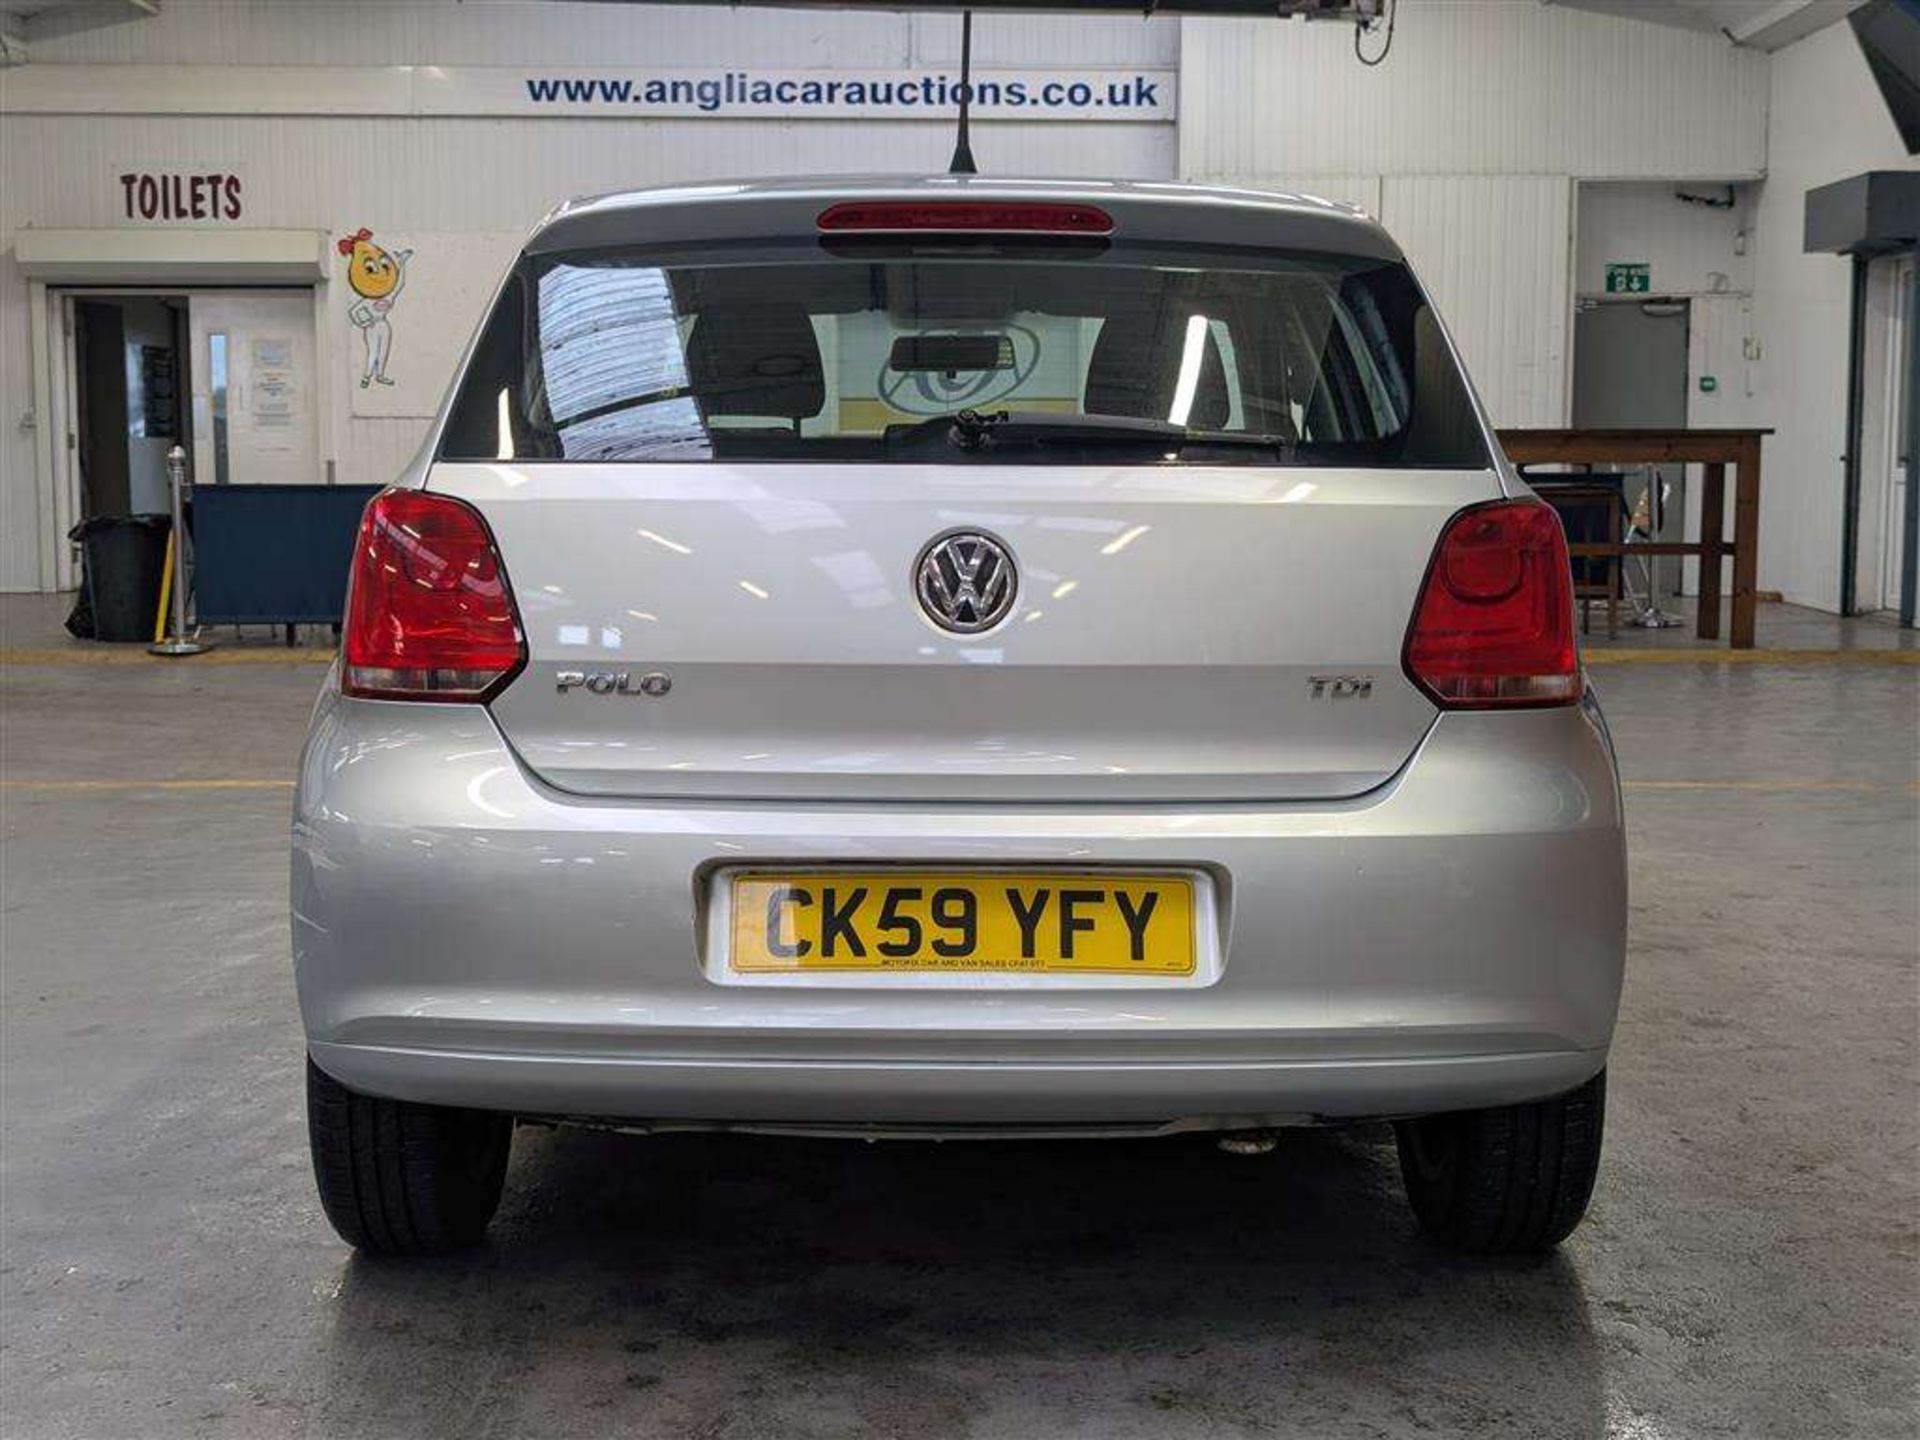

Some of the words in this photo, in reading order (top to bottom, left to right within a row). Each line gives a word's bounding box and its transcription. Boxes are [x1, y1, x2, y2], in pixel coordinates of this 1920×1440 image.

[526, 75, 1158, 111] www.angliacarauctions.co.uk
[119, 173, 242, 220] TOILETS
[556, 670, 672, 697] POLO
[1306, 674, 1372, 699] TDI
[766, 887, 978, 958] CK59
[1005, 888, 1159, 961] YFY
[941, 959, 959, 967] AND
[960, 959, 979, 967] VAN
[980, 959, 1007, 968] SALES
